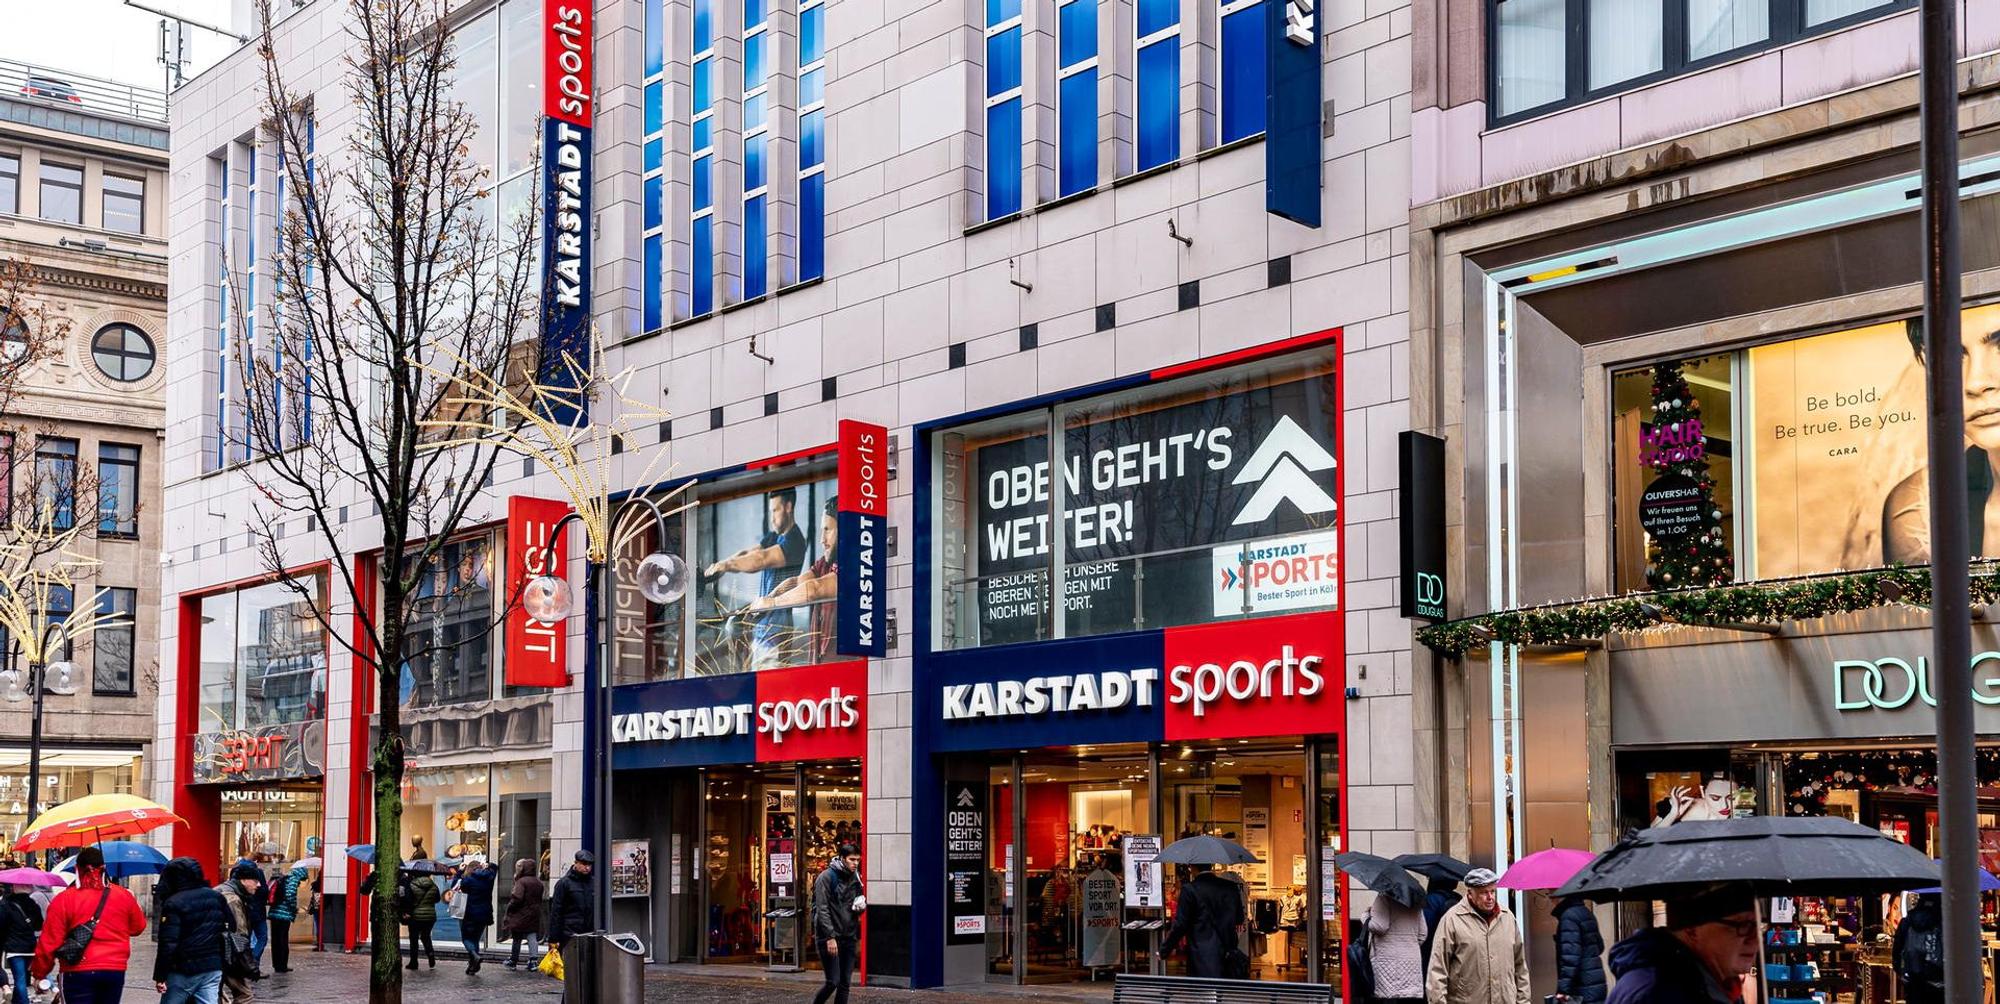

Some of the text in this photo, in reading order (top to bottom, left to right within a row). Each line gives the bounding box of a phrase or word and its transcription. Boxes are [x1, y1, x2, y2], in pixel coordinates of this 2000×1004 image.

[553, 6, 589, 306] KARSTADT sports
[1807, 387, 1881, 412] Be bold.
[1639, 419, 1703, 448] HAIR
[1775, 410, 1916, 440] Be true. Be you.
[1639, 444, 1704, 466] STUDIO
[1829, 446, 1858, 457] CARA
[989, 426, 1233, 510] OBEN GEHT'S
[1644, 517, 1655, 526] auf
[1676, 513, 1700, 523] Besuch
[1647, 507, 1660, 515] Wir
[1662, 506, 1684, 514] freuen
[858, 433, 877, 646] KARSTADT sports
[988, 500, 1134, 562] WEIER!
[1238, 543, 1307, 563] KARSTADT
[1237, 552, 1337, 591] SPORTS
[988, 586, 1032, 604] OBEREN
[1044, 579, 1088, 597] EGEN
[1091, 576, 1113, 592] MIT
[1257, 590, 1283, 601] Bester
[1285, 587, 1307, 600] Sport
[1309, 586, 1317, 596] in
[989, 604, 1018, 620] NOCH
[1063, 595, 1093, 610] PORT.
[1417, 605, 1444, 618] DOUGLAS
[943, 645, 1325, 719] KARSTADT sports
[612, 687, 858, 743] KARSTADT sports
[949, 811, 983, 826] OBEN
[949, 828, 983, 839] GEHT'S
[949, 840, 983, 851] WEITER!
[1088, 880, 1116, 889] BESTER
[1088, 890, 1112, 901] SPORT
